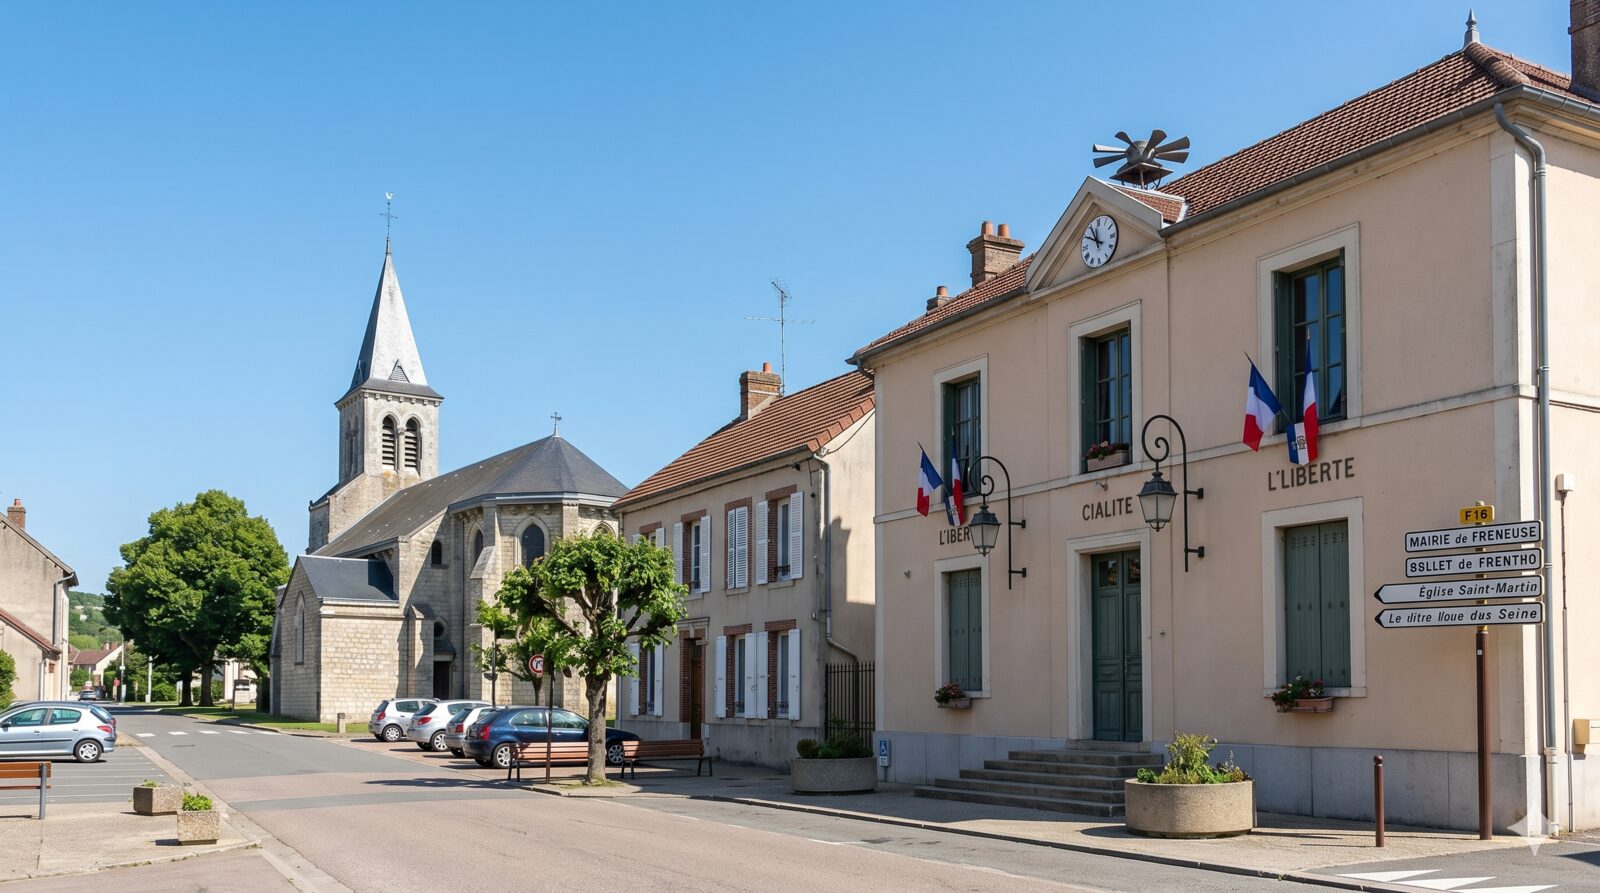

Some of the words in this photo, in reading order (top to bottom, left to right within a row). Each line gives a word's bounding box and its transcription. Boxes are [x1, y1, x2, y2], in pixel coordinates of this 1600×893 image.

[1082, 496, 1133, 521] CIALITE
[1465, 509, 1488, 521] F16
[1410, 534, 1450, 548] MAIRIE
[1455, 533, 1468, 544] de
[1472, 526, 1537, 542] FRENEUSE
[1458, 558, 1473, 570] de
[1479, 553, 1537, 568] FRENTHO
[1419, 585, 1454, 600] Église
[1458, 581, 1538, 596] Saint-Martin
[1388, 613, 1402, 624] Le
[1498, 608, 1537, 620] Seine
